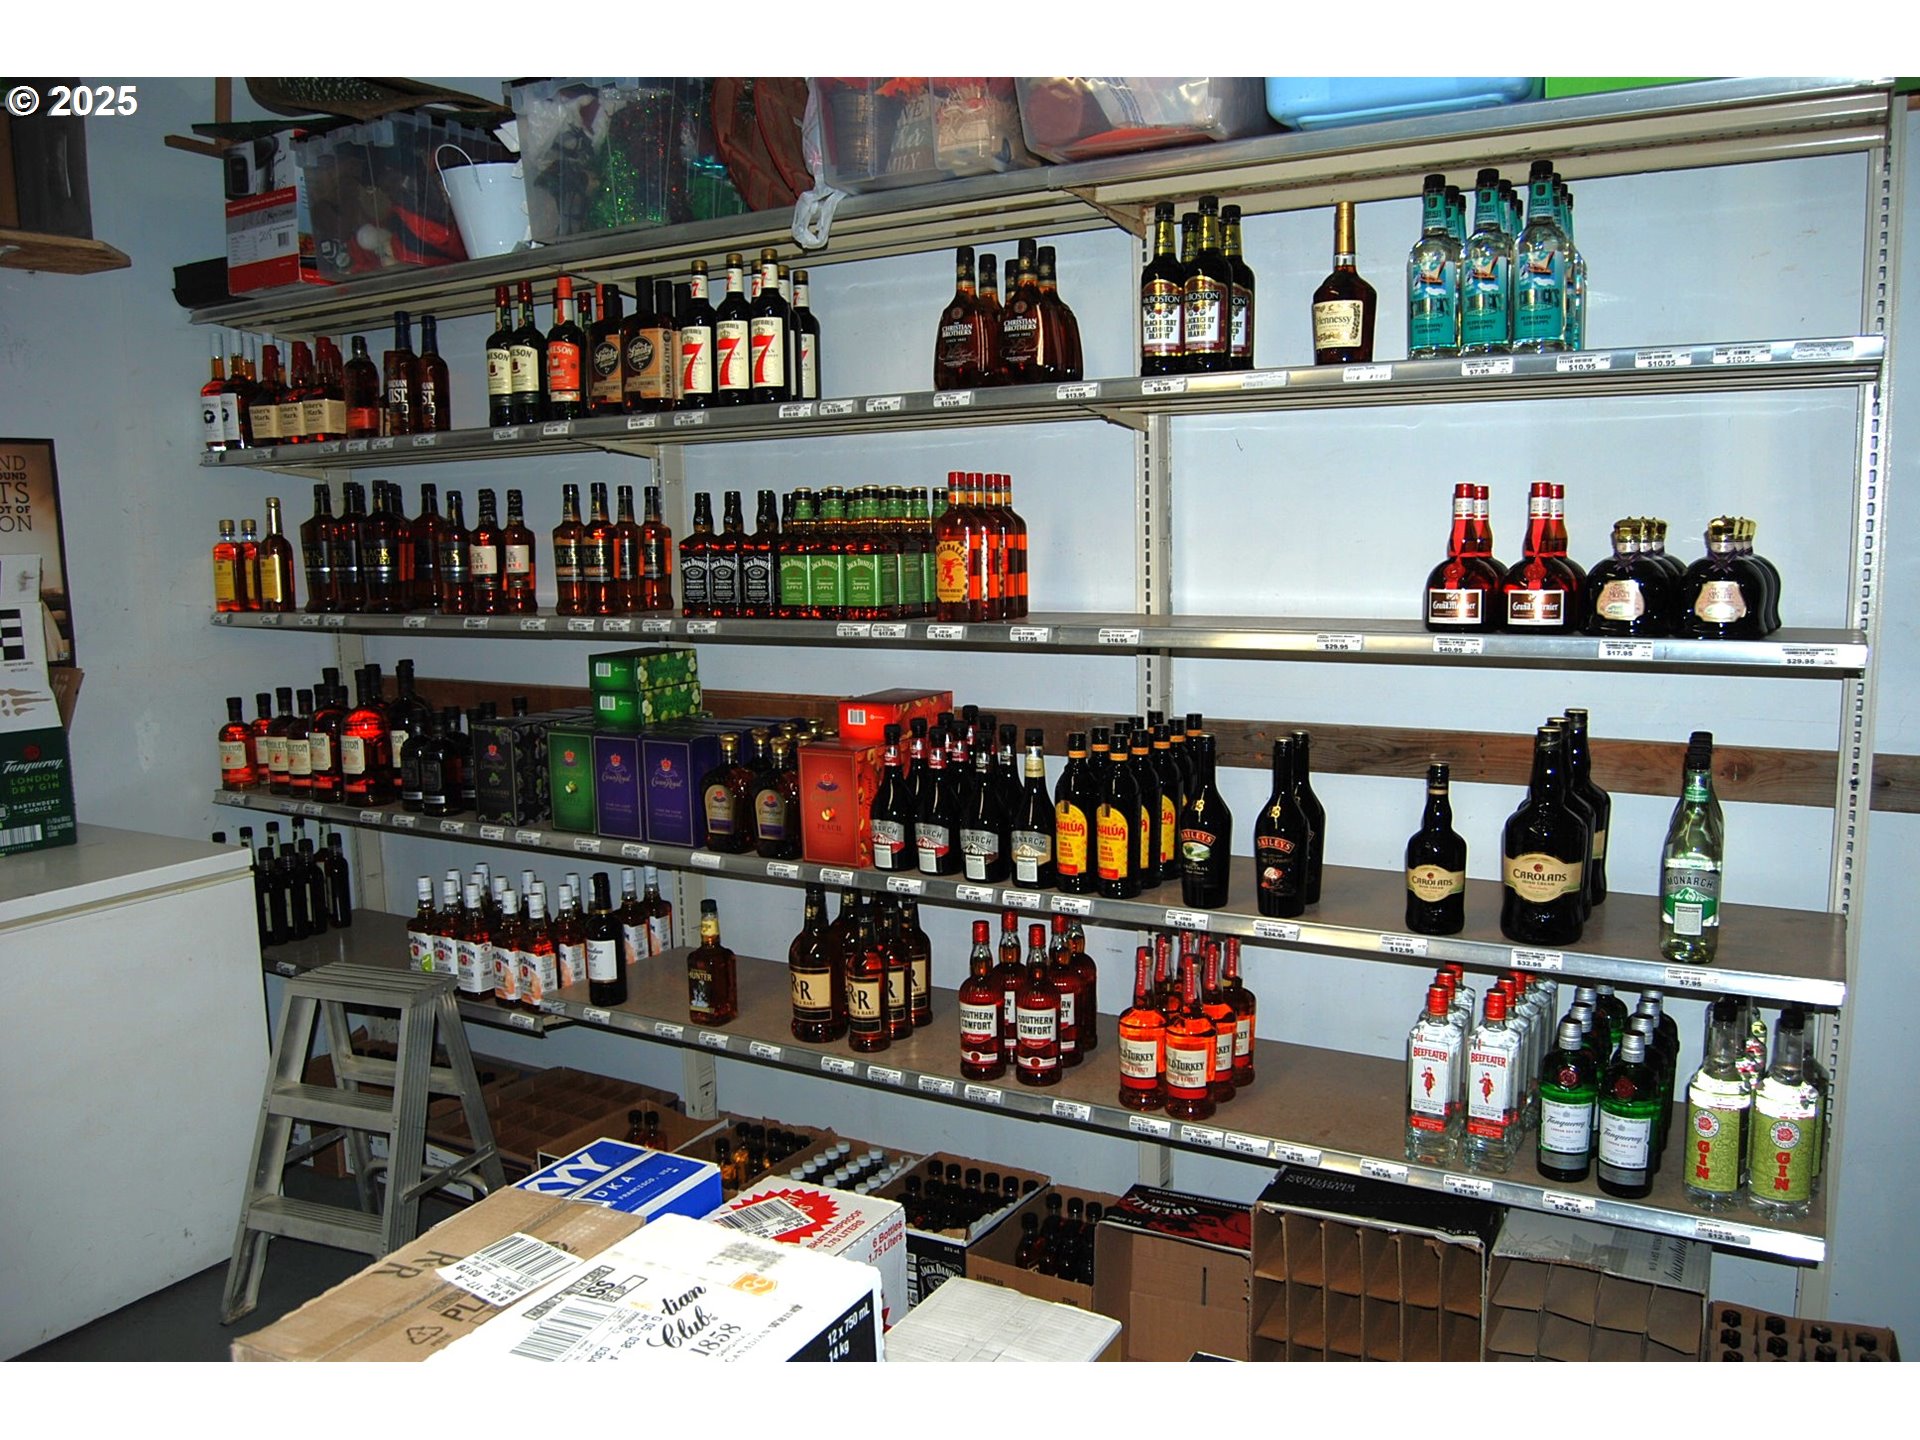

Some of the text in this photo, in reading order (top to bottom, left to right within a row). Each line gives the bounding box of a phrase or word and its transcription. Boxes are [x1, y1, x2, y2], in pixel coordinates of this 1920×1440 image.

[1150, 296, 1180, 304] BOSTON
[1189, 292, 1219, 301] BOSTON
[1004, 317, 1037, 326] CHRISTIAN
[1317, 314, 1351, 325] Hennessy
[682, 343, 704, 390] 7
[717, 337, 741, 385] 7
[752, 334, 776, 384] 7
[1568, 362, 1596, 370] $10.95
[1647, 359, 1676, 367] $10.95
[17, 505, 31, 514] OF
[4, 756, 65, 774] Tanqueray
[11, 772, 60, 787] LONDON
[12, 780, 61, 796] DRY GIN
[23, 805, 53, 815] CHOICE
[1181, 830, 1214, 844] BAILEYS
[1258, 837, 1291, 852] BAILEYS
[1512, 868, 1567, 882] CAROLANS
[1667, 874, 1714, 888] MONARCH
[1679, 979, 1702, 987] $7.95
[961, 1009, 994, 1021] SOUTHERN
[1018, 1014, 1053, 1025] SOUTHERN
[962, 1019, 991, 1030] COMFORT
[1020, 1024, 1051, 1035] COMFORT
[1127, 1050, 1154, 1062] TURKEY
[1413, 1046, 1448, 1062] BEEFEATER
[1470, 1052, 1506, 1068] BEEFEATER
[1176, 1060, 1205, 1071] TURKEY
[1546, 1115, 1586, 1129] Tanqueray
[1602, 1128, 1643, 1144] Tanqueray
[1696, 1140, 1711, 1180] GIN
[1774, 1152, 1791, 1191] GIN
[1127, 1194, 1199, 1216] FIREBALL
[807, 1209, 863, 1250] SHATTERPROOF
[823, 1219, 866, 1249] 1.75 LITERS
[872, 1219, 904, 1249] 6 Bottles
[868, 1231, 904, 1264] 1.75 Liters
[919, 1263, 936, 1278] JACK
[646, 1305, 712, 1349] Club
[828, 1301, 871, 1346] 12 x 750 mL
[689, 1323, 742, 1356] 1858
[839, 1340, 850, 1357] kg
